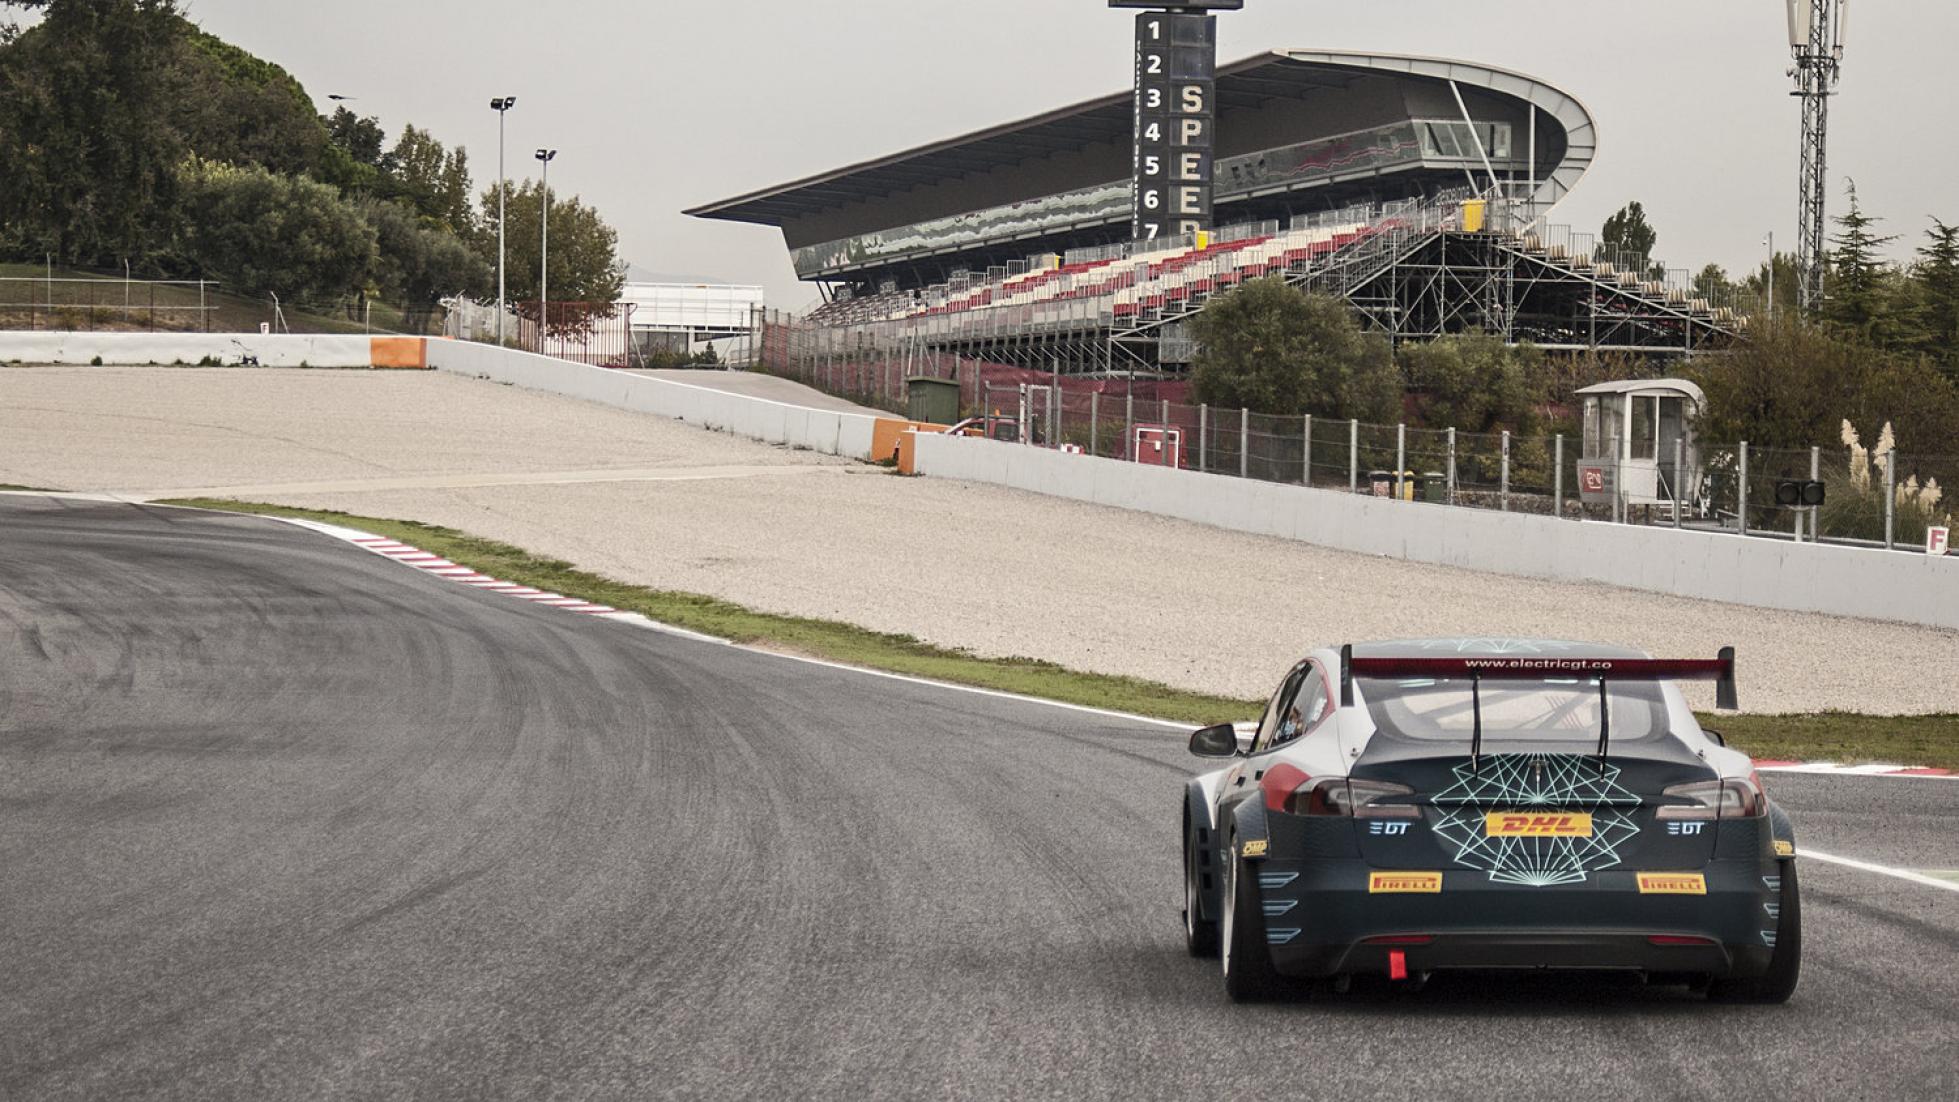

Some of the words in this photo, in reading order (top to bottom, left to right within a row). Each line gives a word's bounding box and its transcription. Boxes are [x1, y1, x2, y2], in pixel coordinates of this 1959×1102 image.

[1148, 21, 1159, 39] 1
[1147, 55, 1161, 73] 2
[1147, 88, 1161, 107] 3
[1144, 123, 1161, 141] 4
[1145, 156, 1160, 175] 5
[1144, 190, 1159, 209] 6
[1144, 223, 1159, 241] 7
[1931, 530, 1945, 550] F
[1465, 659, 1612, 670] www.electricgt.co
[1502, 817, 1578, 832] DHL
[1373, 877, 1437, 889] PIRELLI
[1641, 878, 1701, 889] PIRELLI
